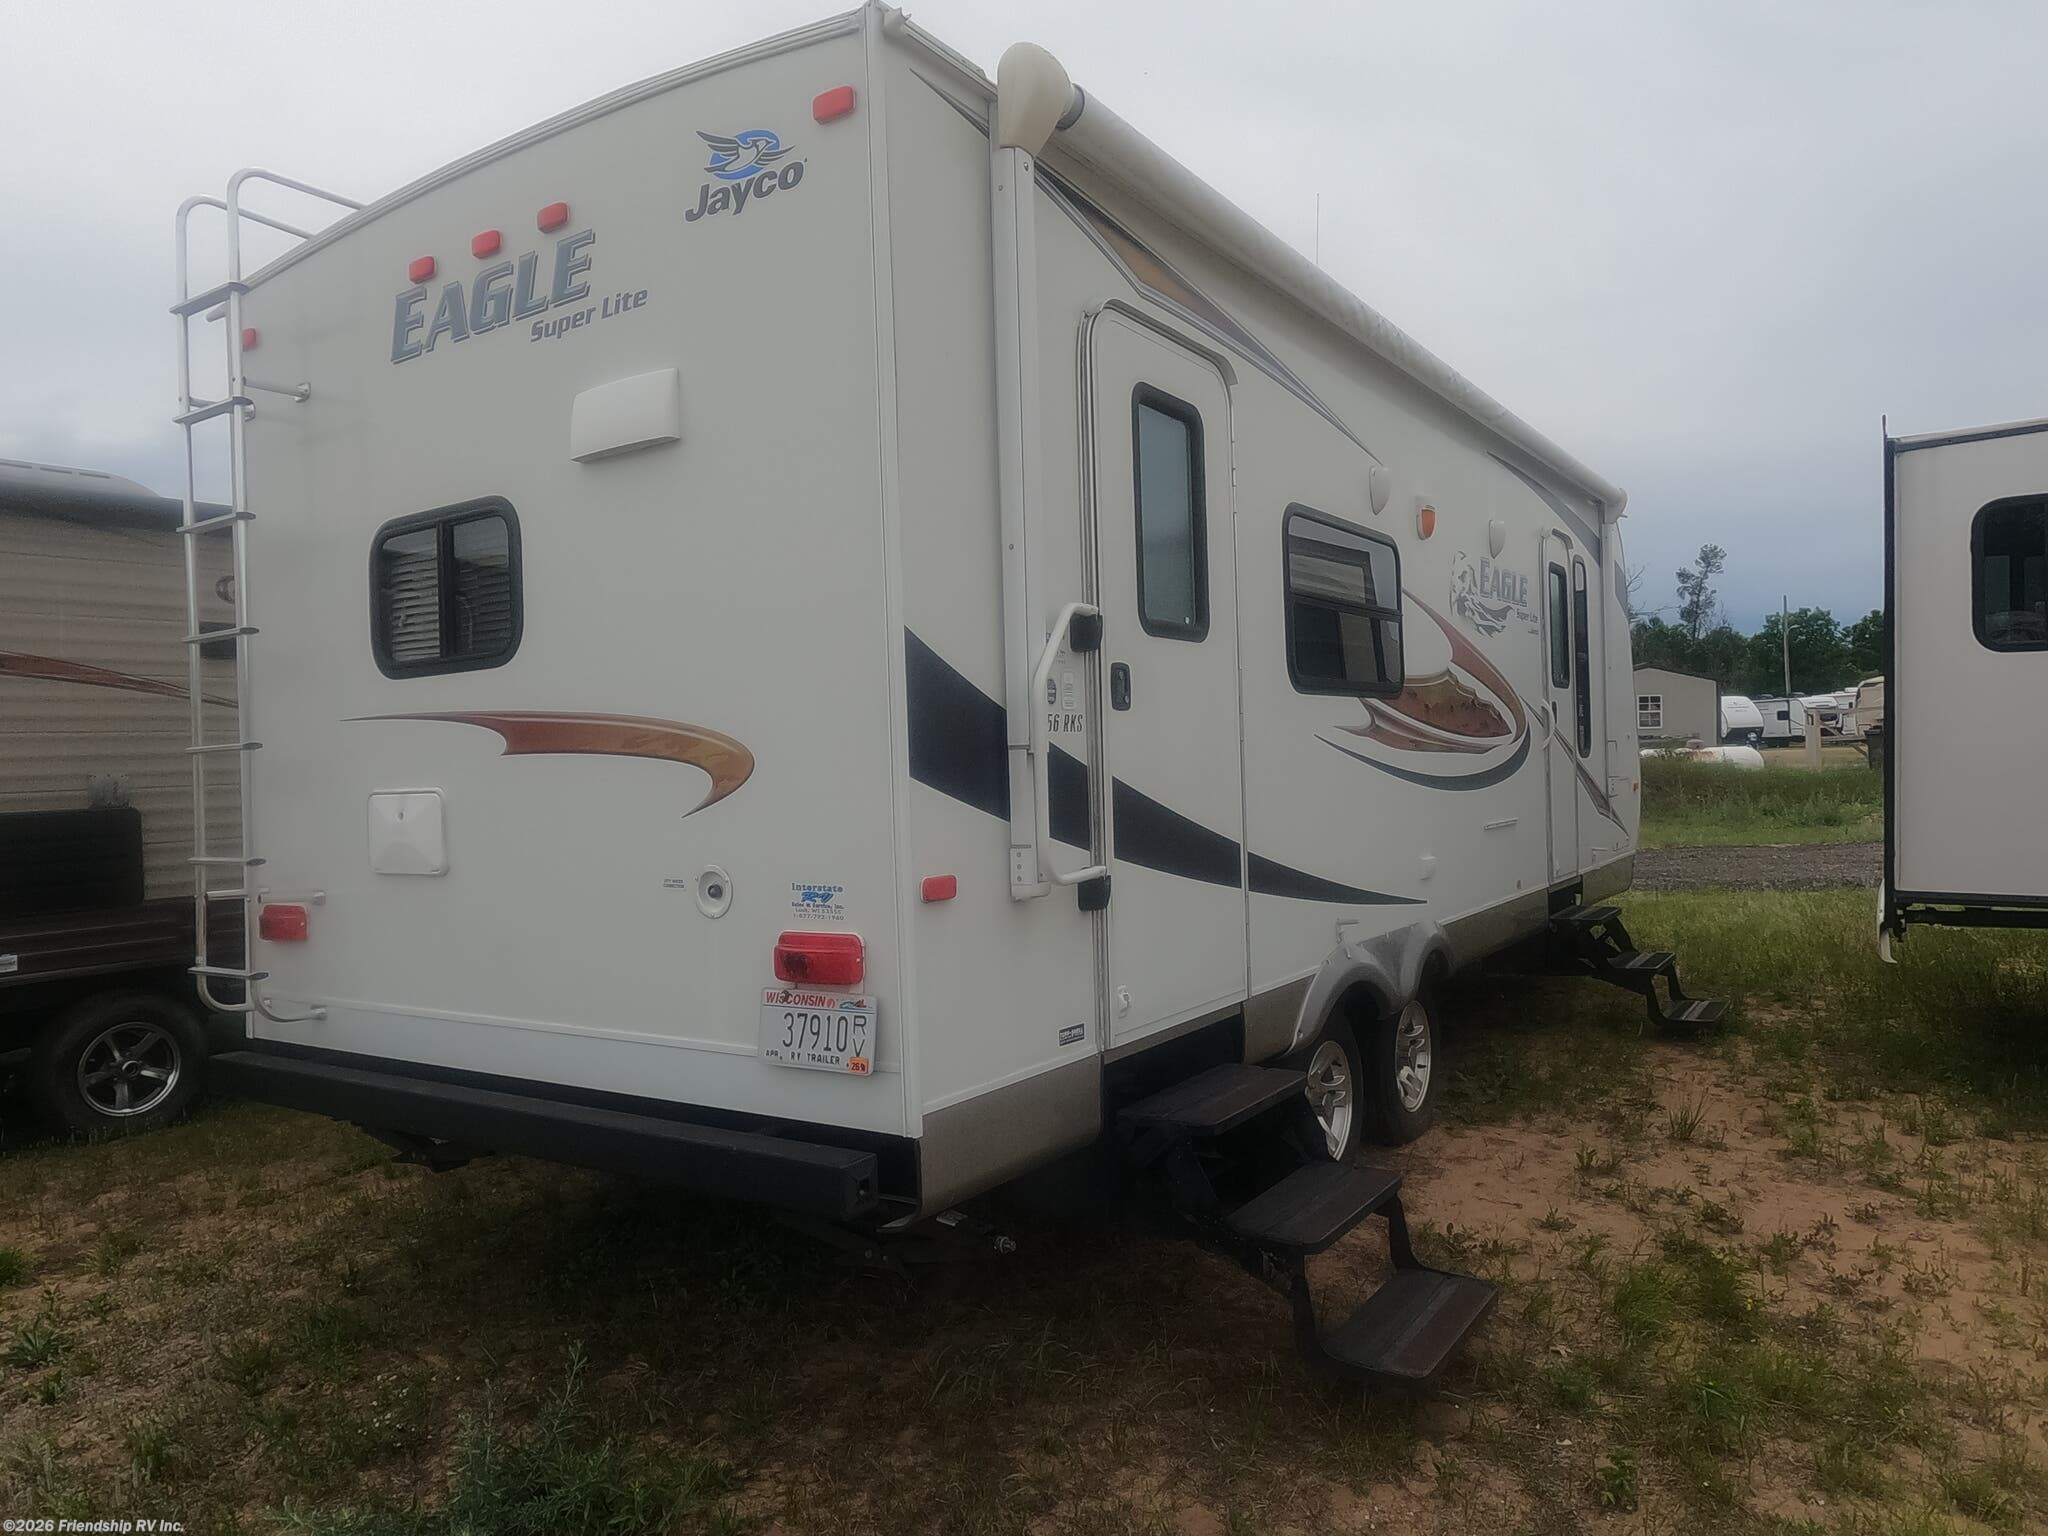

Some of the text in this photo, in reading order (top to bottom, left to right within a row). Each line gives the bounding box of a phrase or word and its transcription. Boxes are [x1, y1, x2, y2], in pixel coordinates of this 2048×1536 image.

[685, 161, 805, 222] Jayco
[391, 229, 596, 365] EAGLE
[531, 289, 648, 342] Super Lite
[1480, 557, 1528, 608] EAGLE
[1063, 714, 1083, 732] RKS
[791, 882, 844, 893] Interstate
[782, 1012, 848, 1053] 37910
[807, 1053, 840, 1065] TRAILER
